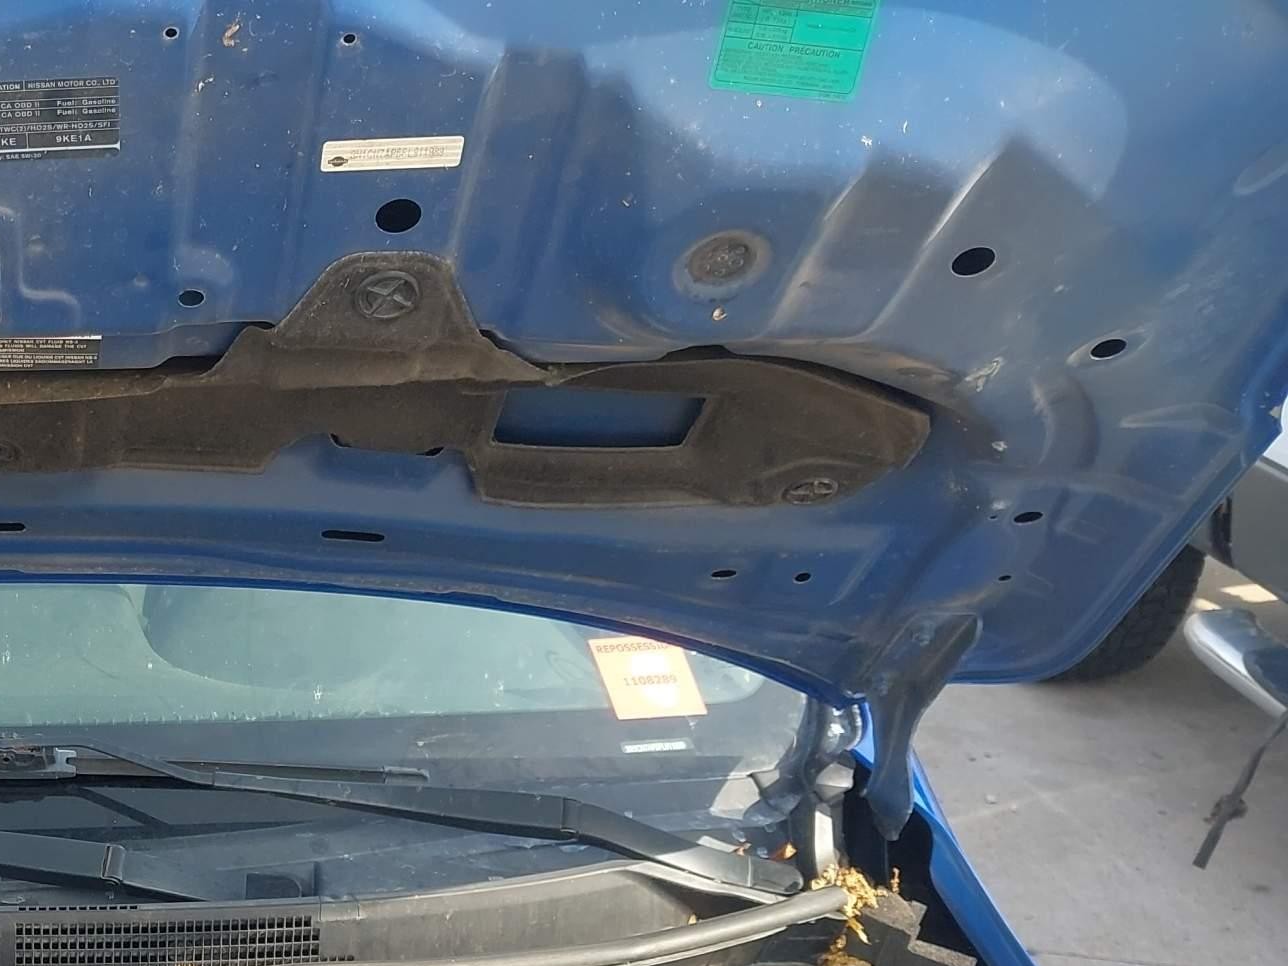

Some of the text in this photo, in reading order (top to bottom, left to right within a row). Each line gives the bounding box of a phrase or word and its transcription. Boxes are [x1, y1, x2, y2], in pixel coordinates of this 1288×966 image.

[748, 42, 783, 52] CAUTION
[1, 138, 16, 146] KE
[56, 134, 92, 143] 9KE1A
[596, 642, 668, 654] REPOSSESSI
